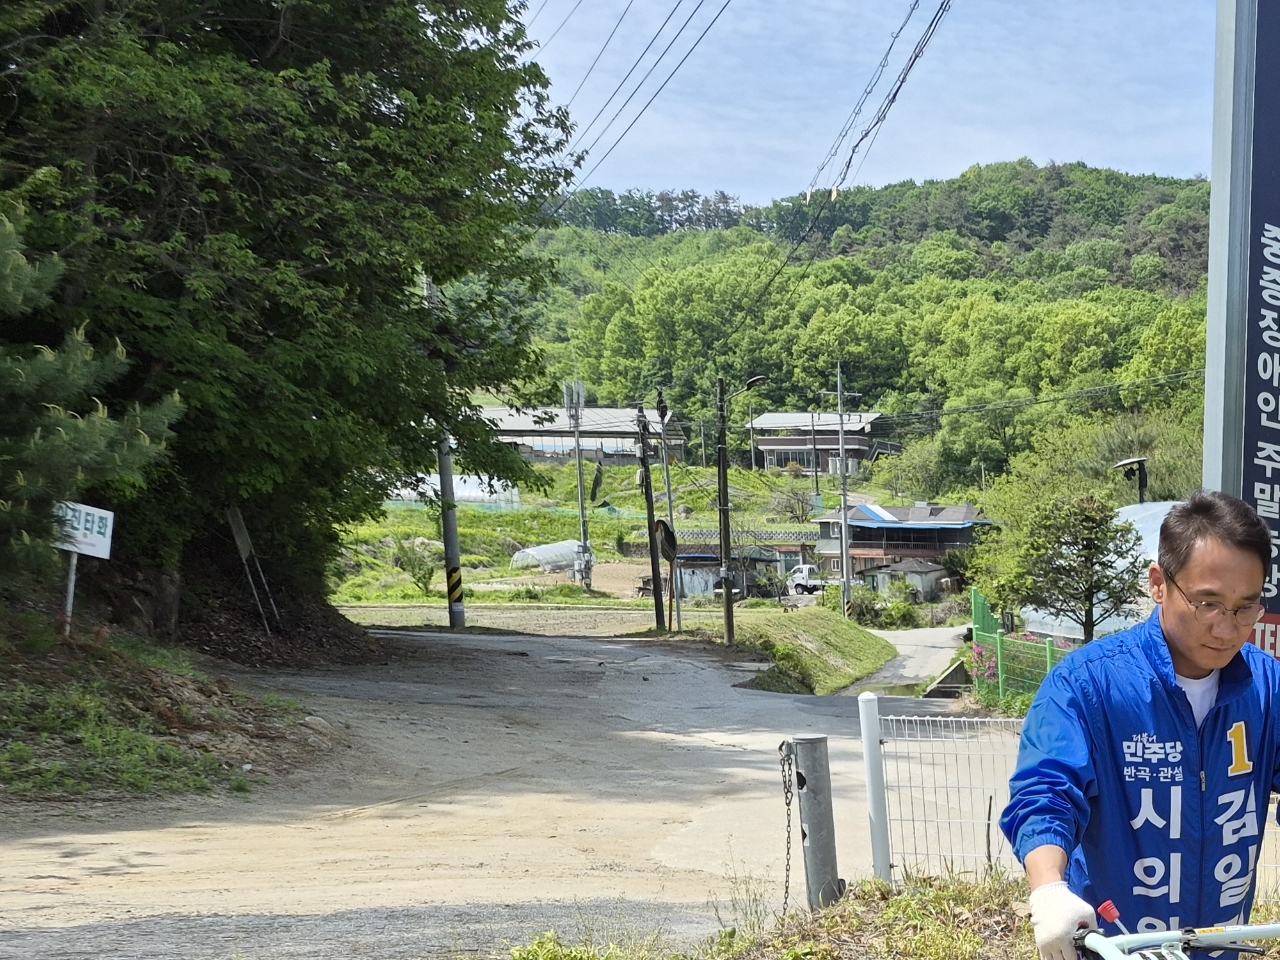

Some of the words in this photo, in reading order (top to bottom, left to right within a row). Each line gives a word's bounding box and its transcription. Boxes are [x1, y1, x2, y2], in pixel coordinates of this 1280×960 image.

[1132, 732, 1157, 744] 더불어
[1122, 741, 1184, 763] 민주당
[1227, 721, 1254, 777] 1
[1123, 765, 1184, 782] 반곡·관설
